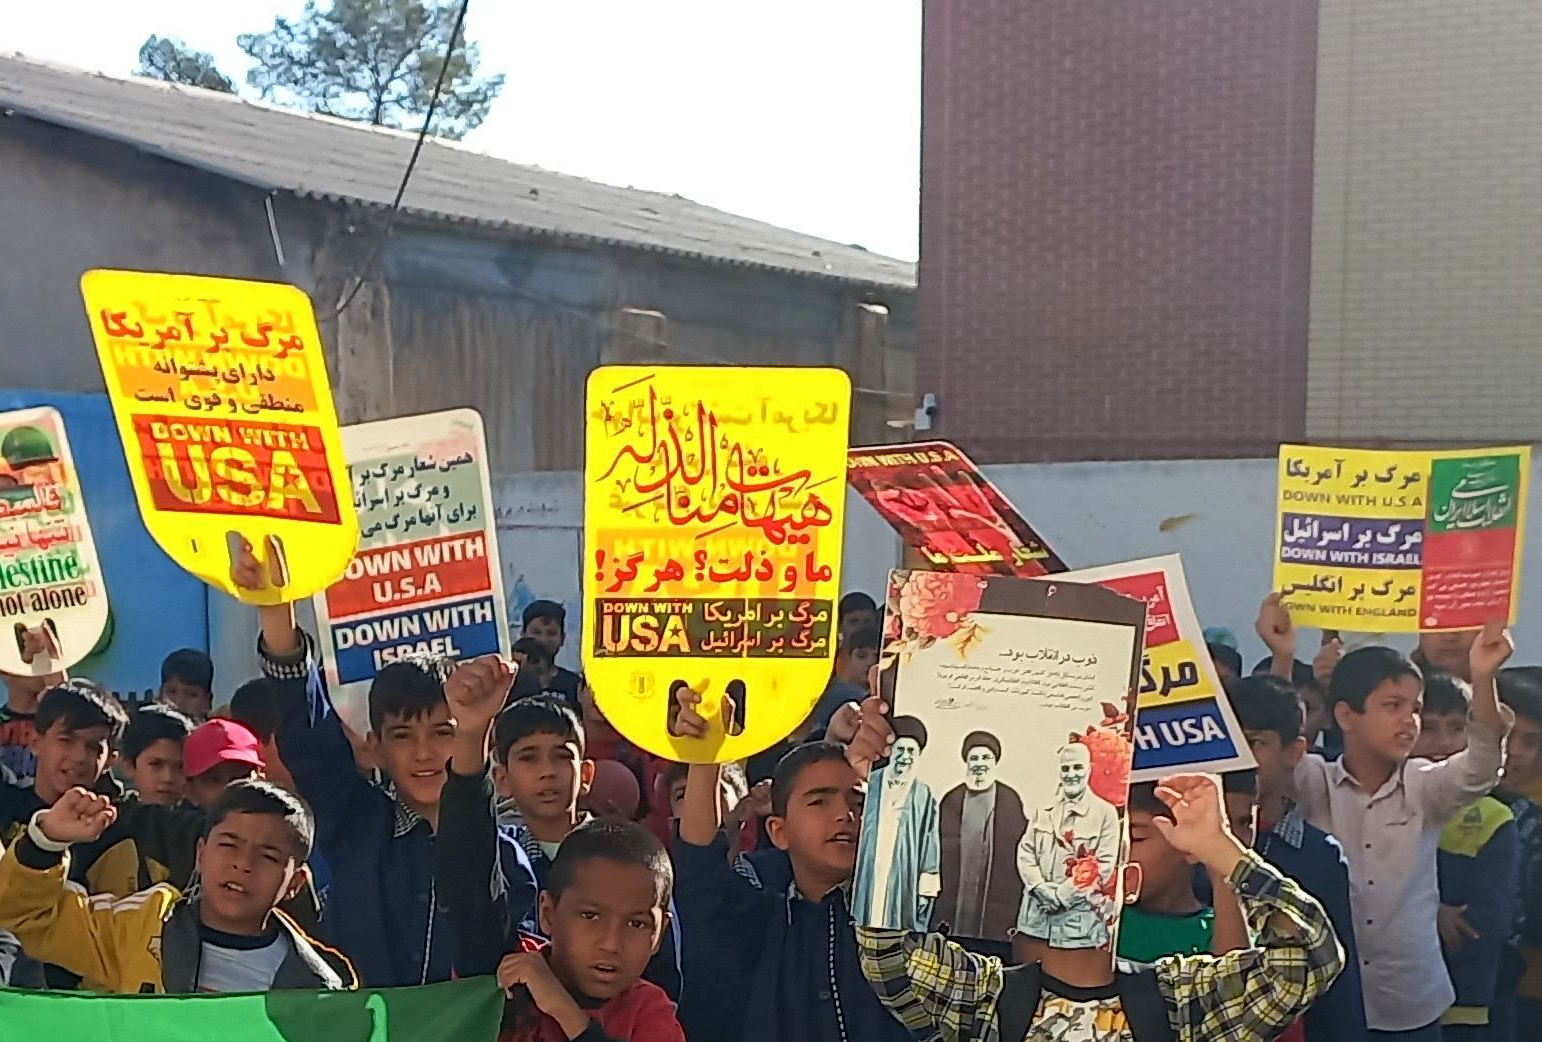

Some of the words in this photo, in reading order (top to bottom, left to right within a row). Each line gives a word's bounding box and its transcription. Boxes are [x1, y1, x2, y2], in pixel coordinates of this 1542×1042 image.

[101, 309, 194, 349] آمریکا
[206, 327, 229, 353] بر
[241, 322, 304, 359] مرگ
[221, 362, 275, 385] دارای
[134, 387, 176, 403] است
[243, 394, 304, 415] منطقی
[150, 423, 232, 444] DOWN
[239, 427, 309, 450] WITH
[157, 442, 322, 514] USA
[359, 468, 370, 486] بر
[1286, 458, 1345, 485] آمریکا
[1350, 467, 1367, 488] بر
[1375, 464, 1421, 489] مرگ
[393, 488, 404, 507] بر
[1283, 490, 1330, 504] DOWN
[1336, 494, 1376, 507] WITH
[447, 502, 477, 524] برای
[1284, 519, 1349, 546] اسرائیل
[1352, 527, 1372, 548] بر
[1377, 523, 1422, 550] مرگ
[340, 550, 411, 581] OWN
[414, 539, 483, 567] WITH
[805, 553, 831, 581] ما
[1282, 548, 1327, 561] DOWN
[1330, 550, 1368, 564] WITH
[374, 573, 441, 602] U.S.A
[781, 567, 795, 591] و
[30, 585, 88, 611] alone
[1347, 582, 1365, 601] بر
[1372, 580, 1415, 603] مرگ
[603, 603, 648, 613] DOWN
[651, 603, 693, 613] WITH
[767, 607, 784, 625] بر
[788, 602, 828, 624] مرگ
[1319, 605, 1351, 616] WITH
[337, 614, 421, 650] DOWN
[424, 602, 492, 634] WITH
[603, 615, 690, 652] USA
[767, 634, 784, 652] بر
[791, 630, 826, 649] مرگ
[1160, 716, 1226, 751] USA
